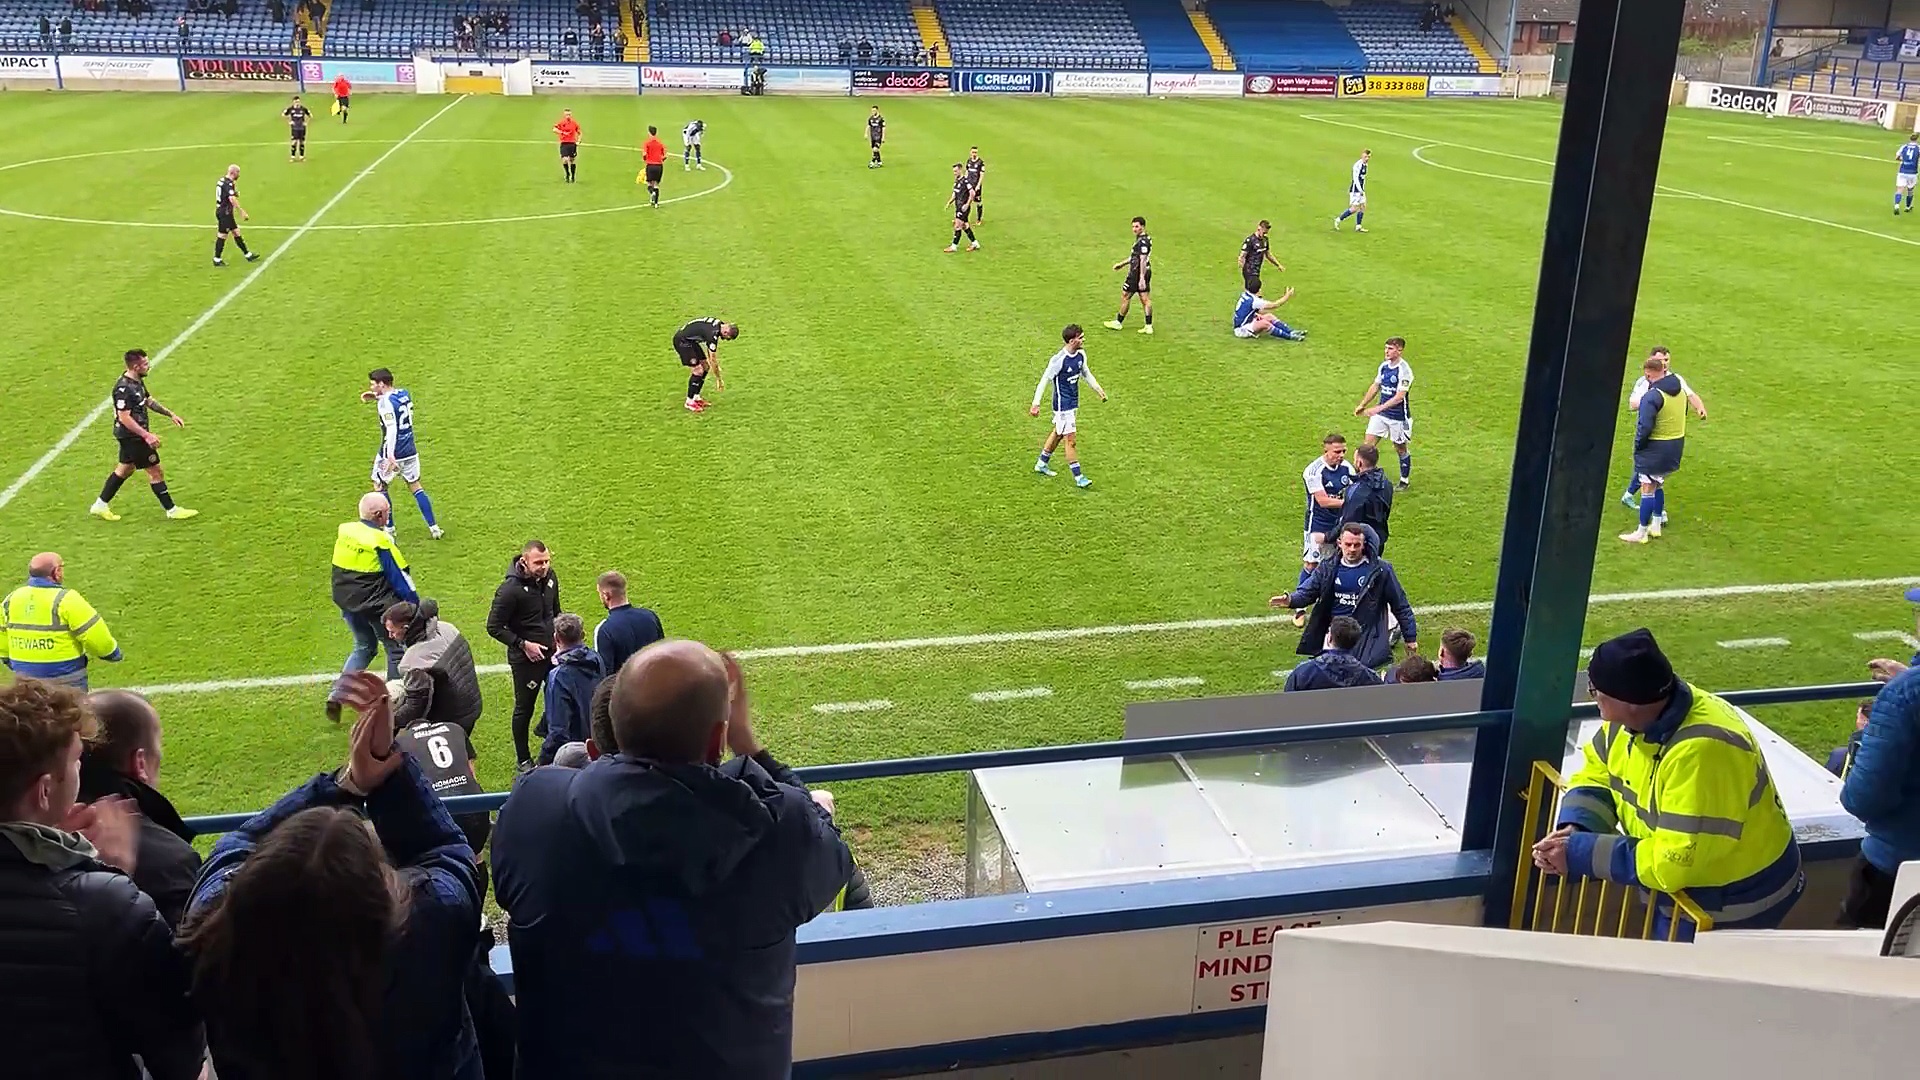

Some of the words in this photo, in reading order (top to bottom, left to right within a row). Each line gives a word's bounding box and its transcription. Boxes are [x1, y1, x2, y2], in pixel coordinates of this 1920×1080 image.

[984, 73, 1031, 85] CREAGH
[1368, 81, 1382, 90] 38
[1384, 81, 1404, 91] 333
[1405, 82, 1425, 91] 888
[1708, 86, 1775, 113] Bedeck
[427, 735, 453, 769] 6
[1218, 920, 1322, 949] PLEA
[1198, 953, 1272, 979] MIND
[1230, 981, 1270, 1002] ST
